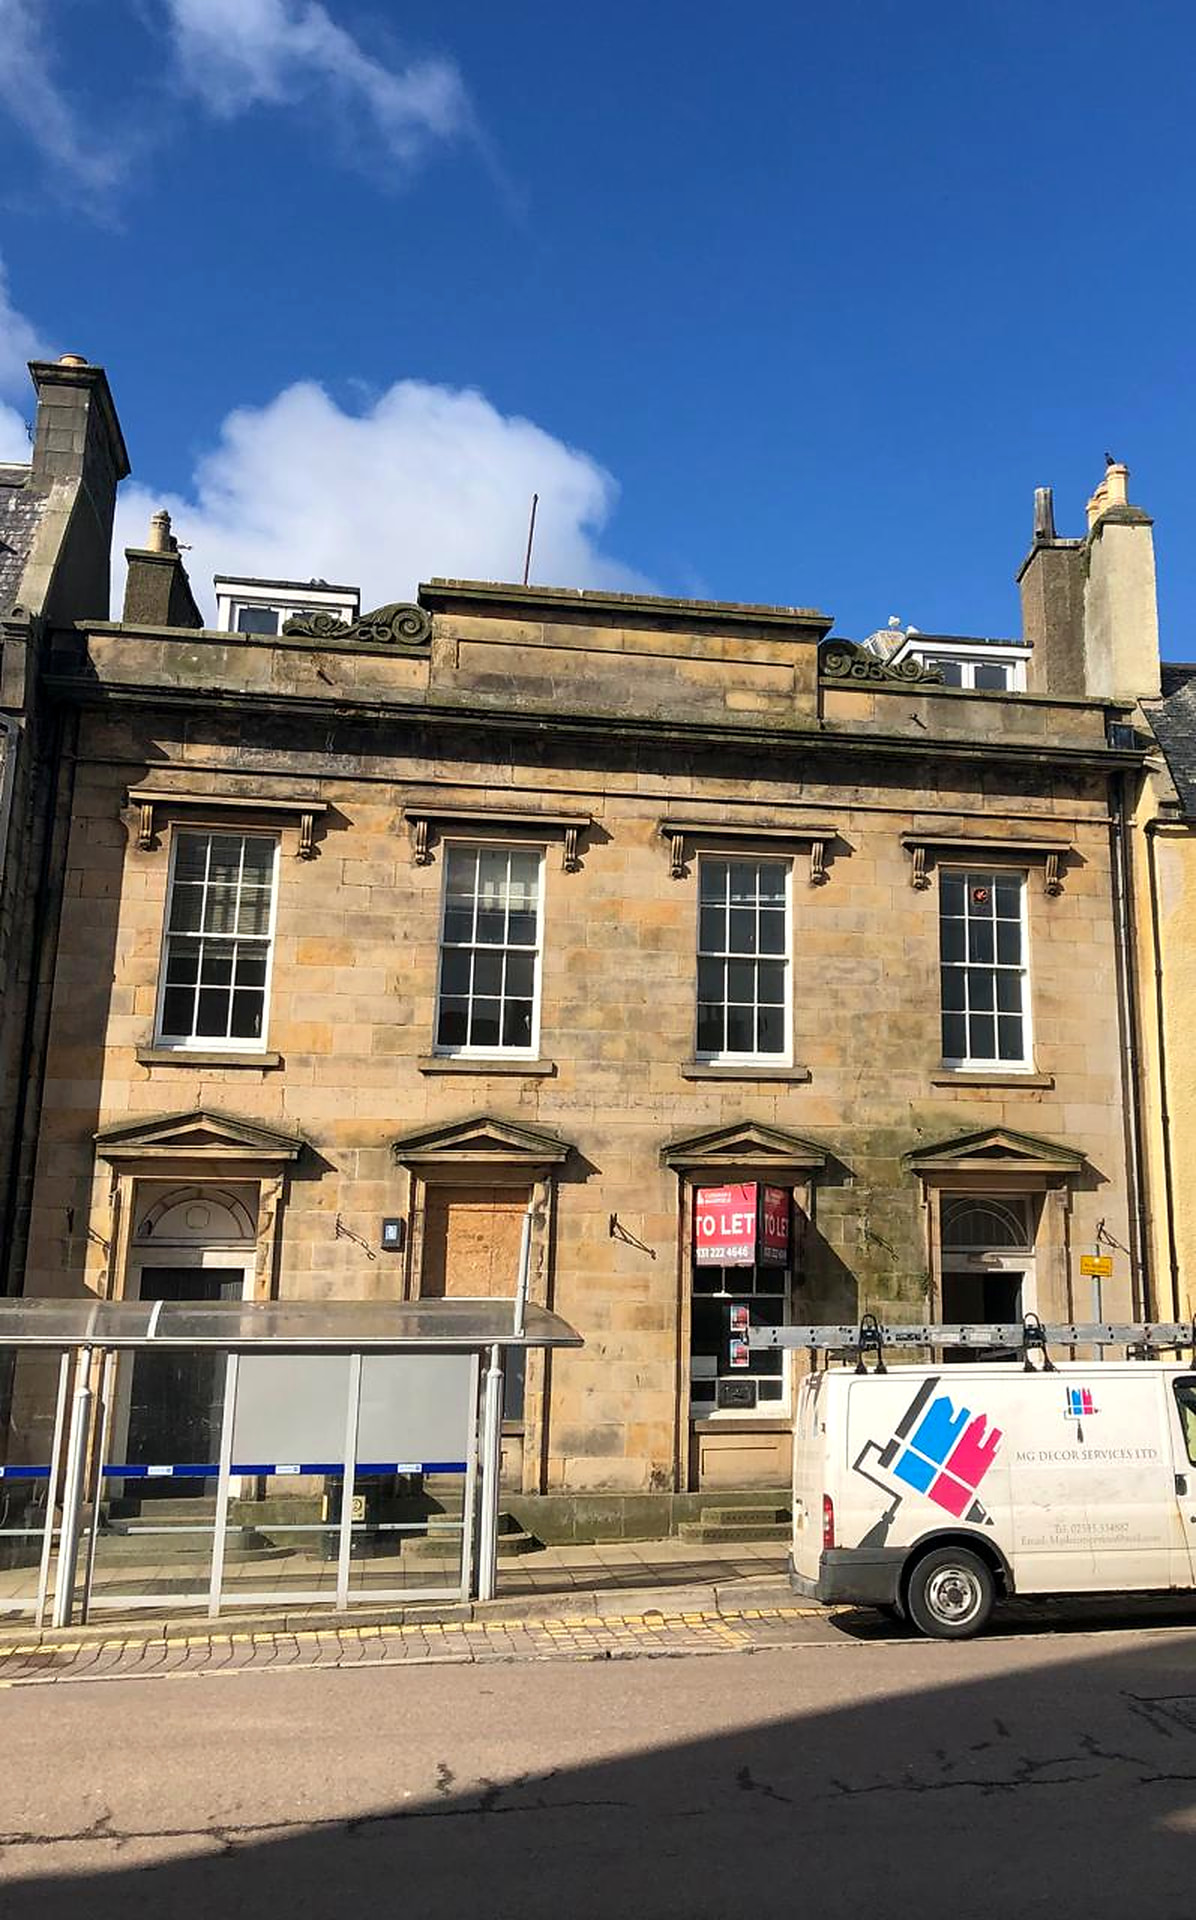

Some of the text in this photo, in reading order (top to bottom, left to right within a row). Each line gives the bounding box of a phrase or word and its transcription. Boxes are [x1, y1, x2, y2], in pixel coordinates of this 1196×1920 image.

[696, 1212, 755, 1237] TO LET
[765, 1213, 775, 1236] TO
[710, 1247, 724, 1258] 222
[725, 1245, 748, 1258] 4646
[1016, 1448, 1158, 1462] MG DECOR SERVICES LTD
